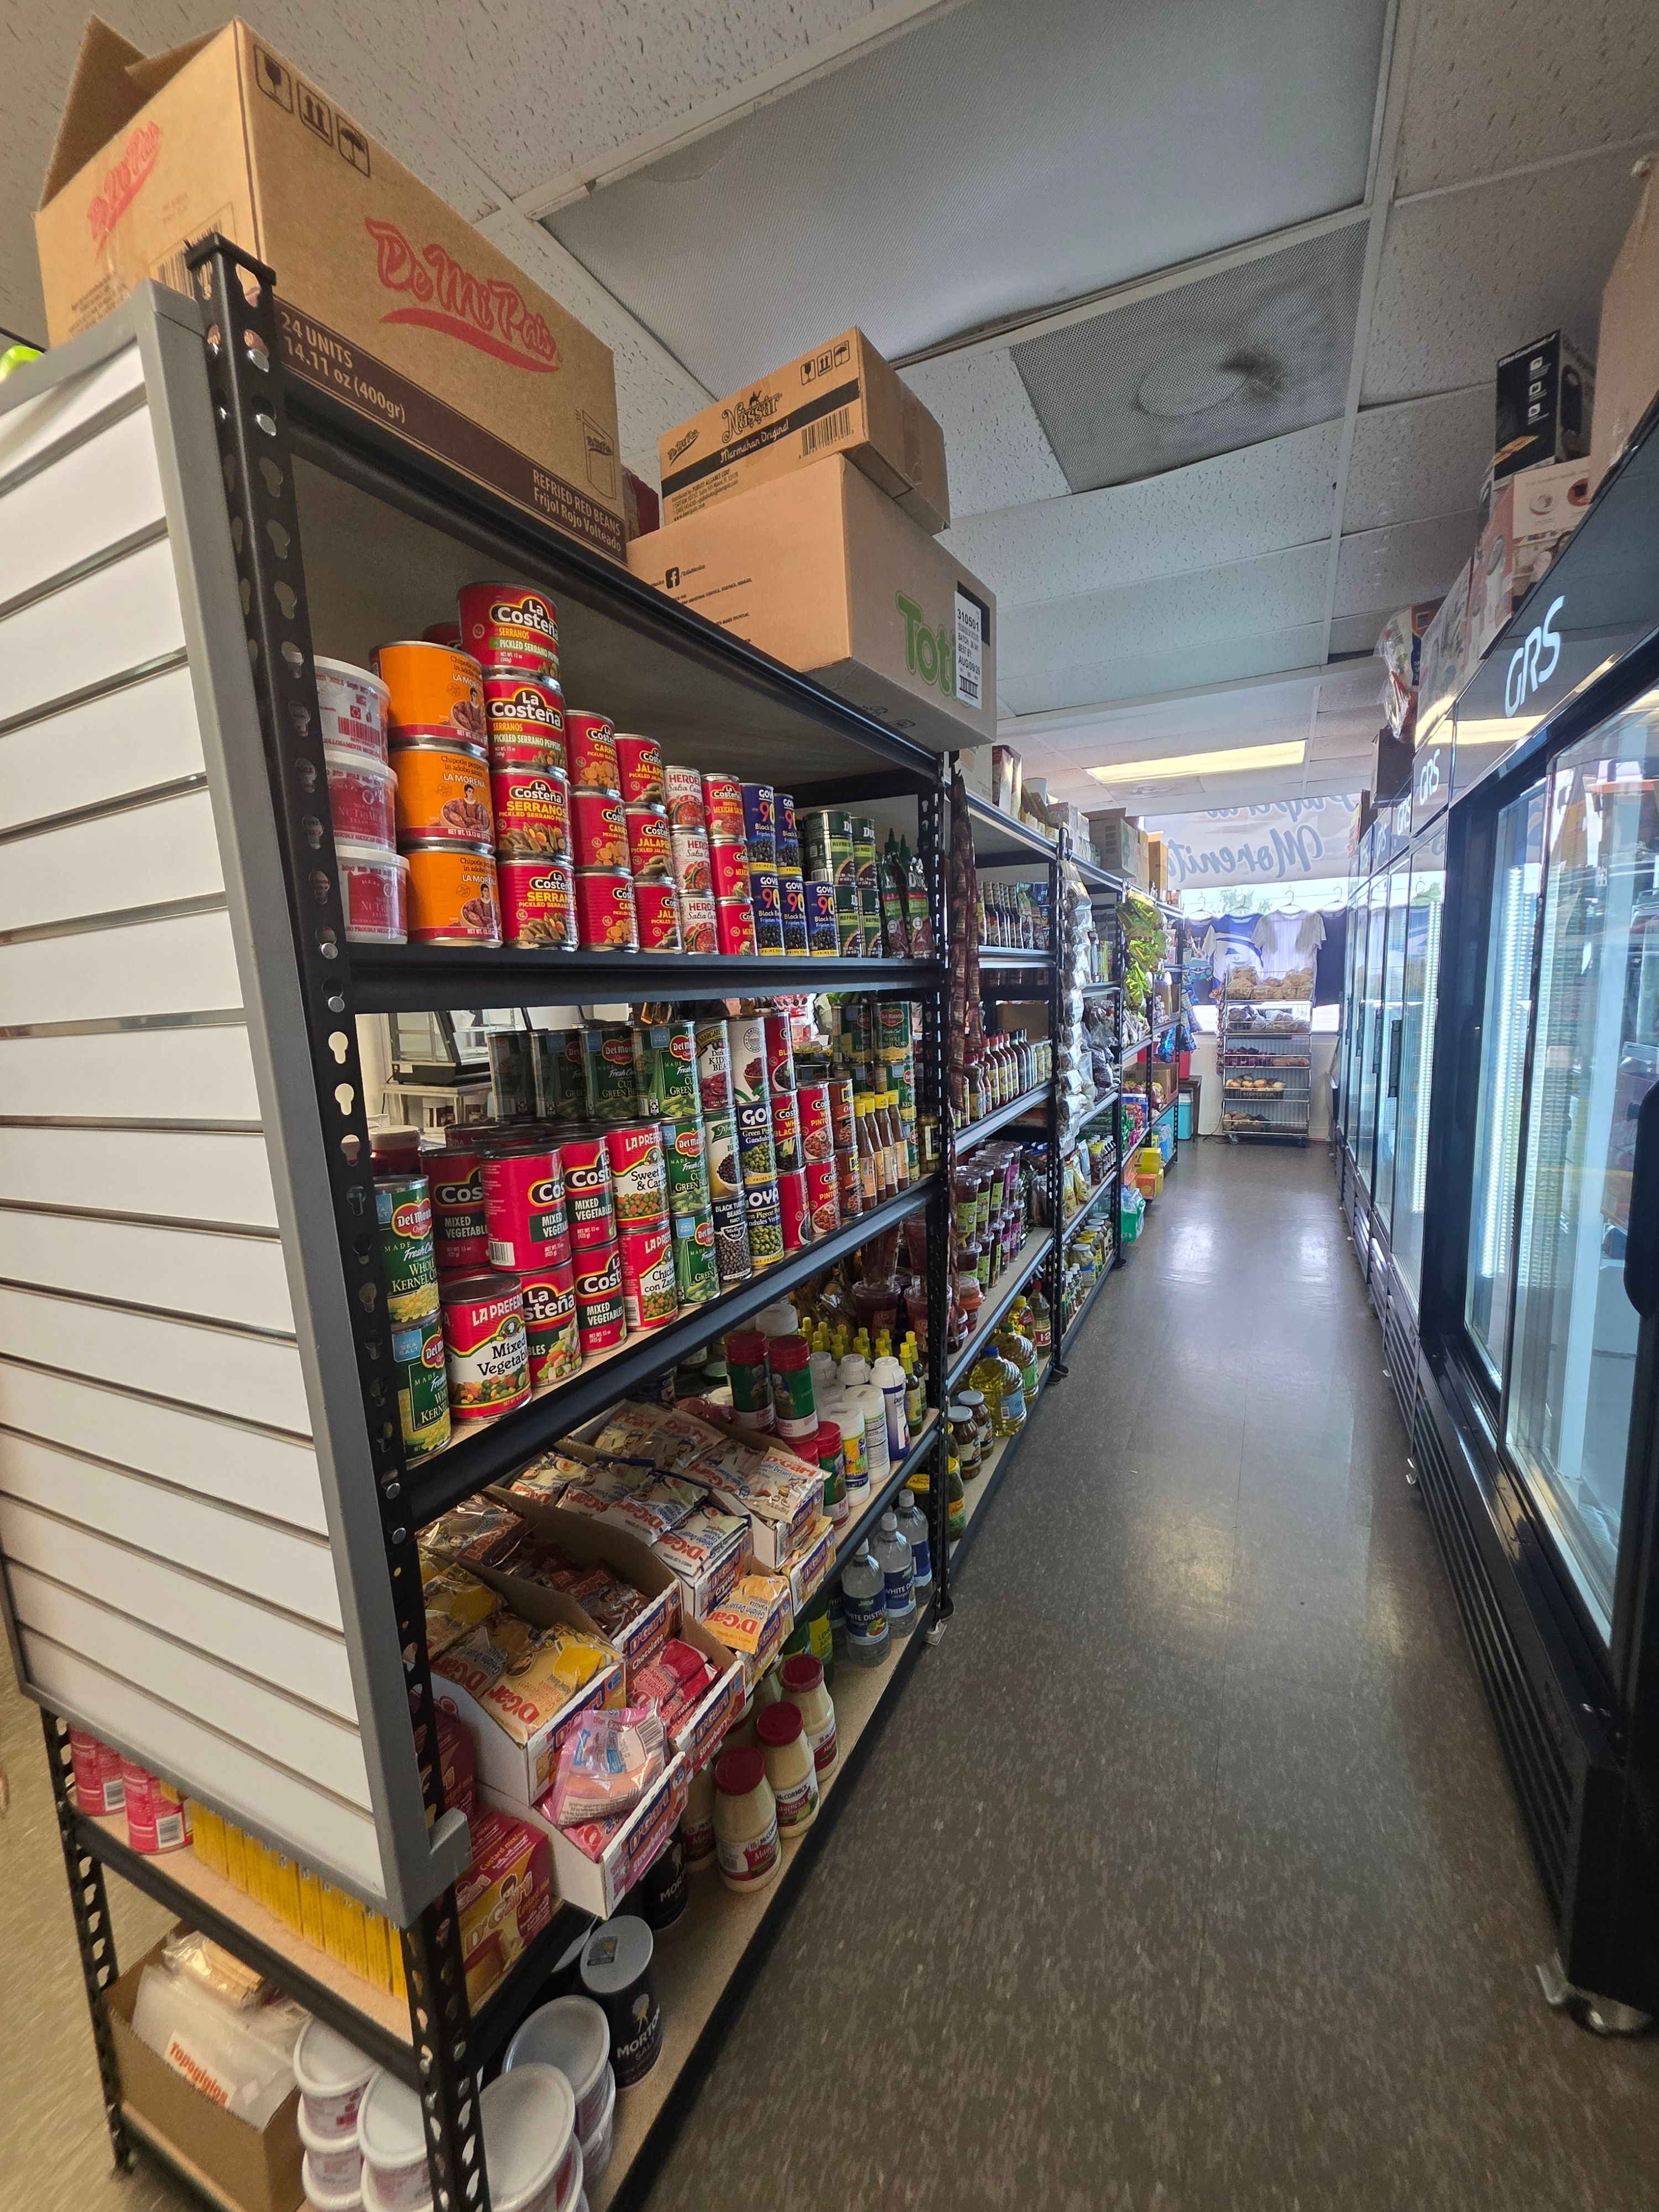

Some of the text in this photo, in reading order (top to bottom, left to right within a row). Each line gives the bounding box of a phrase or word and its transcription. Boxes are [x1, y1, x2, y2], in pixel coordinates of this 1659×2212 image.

[281, 311, 353, 369] 24 UNITS
[284, 336, 406, 424] 14.11 oz (400gr)
[760, 419, 790, 442] Original
[533, 468, 621, 536] REFRIED RED BEANS
[533, 487, 622, 552] Frijol Rojo Volteado
[529, 600, 544, 617] La
[497, 606, 559, 641] Costeña
[957, 608, 980, 632] 310501
[498, 627, 530, 640] SERRANOS
[499, 639, 547, 658] PICKLED SERRANO
[958, 643, 967, 654] BEST
[450, 655, 473, 669] Chipotle
[1505, 595, 1566, 718] GRS
[452, 672, 462, 682] LA
[521, 691, 540, 706] La
[491, 701, 561, 728] Costeña
[492, 722, 523, 732] SERRANOS
[604, 727, 611, 736] La
[493, 734, 562, 752] PICKLED SERRANO PEPPERS
[441, 755, 467, 766] Chipotle
[654, 749, 660, 758] La
[444, 763, 469, 775] in adobo
[635, 763, 664, 777] JALAPE
[443, 773, 486, 789] LA MORENA
[1420, 748, 1441, 806] GRS
[535, 781, 546, 792] La
[667, 782, 687, 792] Salsa
[514, 787, 562, 804] Costeña
[506, 800, 567, 817] SERRANOS
[526, 811, 555, 821] SERRANO
[462, 873, 472, 882] LA
[553, 873, 562, 882] La
[761, 888, 780, 909] 90
[817, 895, 836, 915] 90
[687, 911, 707, 920] Salsa
[674, 1042, 684, 1051] Del
[617, 1079, 634, 1089] CUT
[602, 1087, 627, 1098] GREEN
[742, 1128, 761, 1138] Green
[625, 1135, 639, 1152] LA
[678, 1139, 691, 1149] Del
[601, 1154, 610, 1166] La
[571, 1168, 611, 1187] Cost
[630, 1167, 659, 1182] Sweet
[637, 1181, 646, 1191] &
[575, 1197, 599, 1211] MIXED
[714, 1203, 733, 1213] BLACK
[397, 1208, 432, 1228] Del Mont
[541, 1212, 563, 1227] MIXED
[575, 1203, 613, 1222] VEGETABLES
[756, 1210, 774, 1218] Pigeon
[445, 1216, 471, 1227] MIXED
[384, 1241, 411, 1253] MADE
[403, 1245, 425, 1262] Fresh
[392, 1272, 430, 1293] KERNEL
[583, 1271, 622, 1293] Cost
[644, 1284, 660, 1293] con
[528, 1290, 549, 1305] La
[524, 1293, 575, 1321] steña
[587, 1302, 611, 1317] MIXED
[472, 1307, 488, 1327] LA
[587, 1305, 623, 1327] VEGETABLES
[398, 1347, 419, 1356] SALT
[400, 1342, 417, 1350] SEA
[425, 1345, 437, 1360] Del
[492, 1334, 526, 1360] Mixed
[414, 1371, 437, 1386] MADE
[766, 1455, 818, 1479] D'Gari
[885, 1586, 906, 1595] WHITE
[632, 1634, 665, 1671] Chocolate
[487, 1684, 540, 1725] D'Gar
[698, 1713, 733, 1760] Strawberry
[633, 1818, 669, 1872] Strawberry
[479, 1841, 505, 1871] Custard
